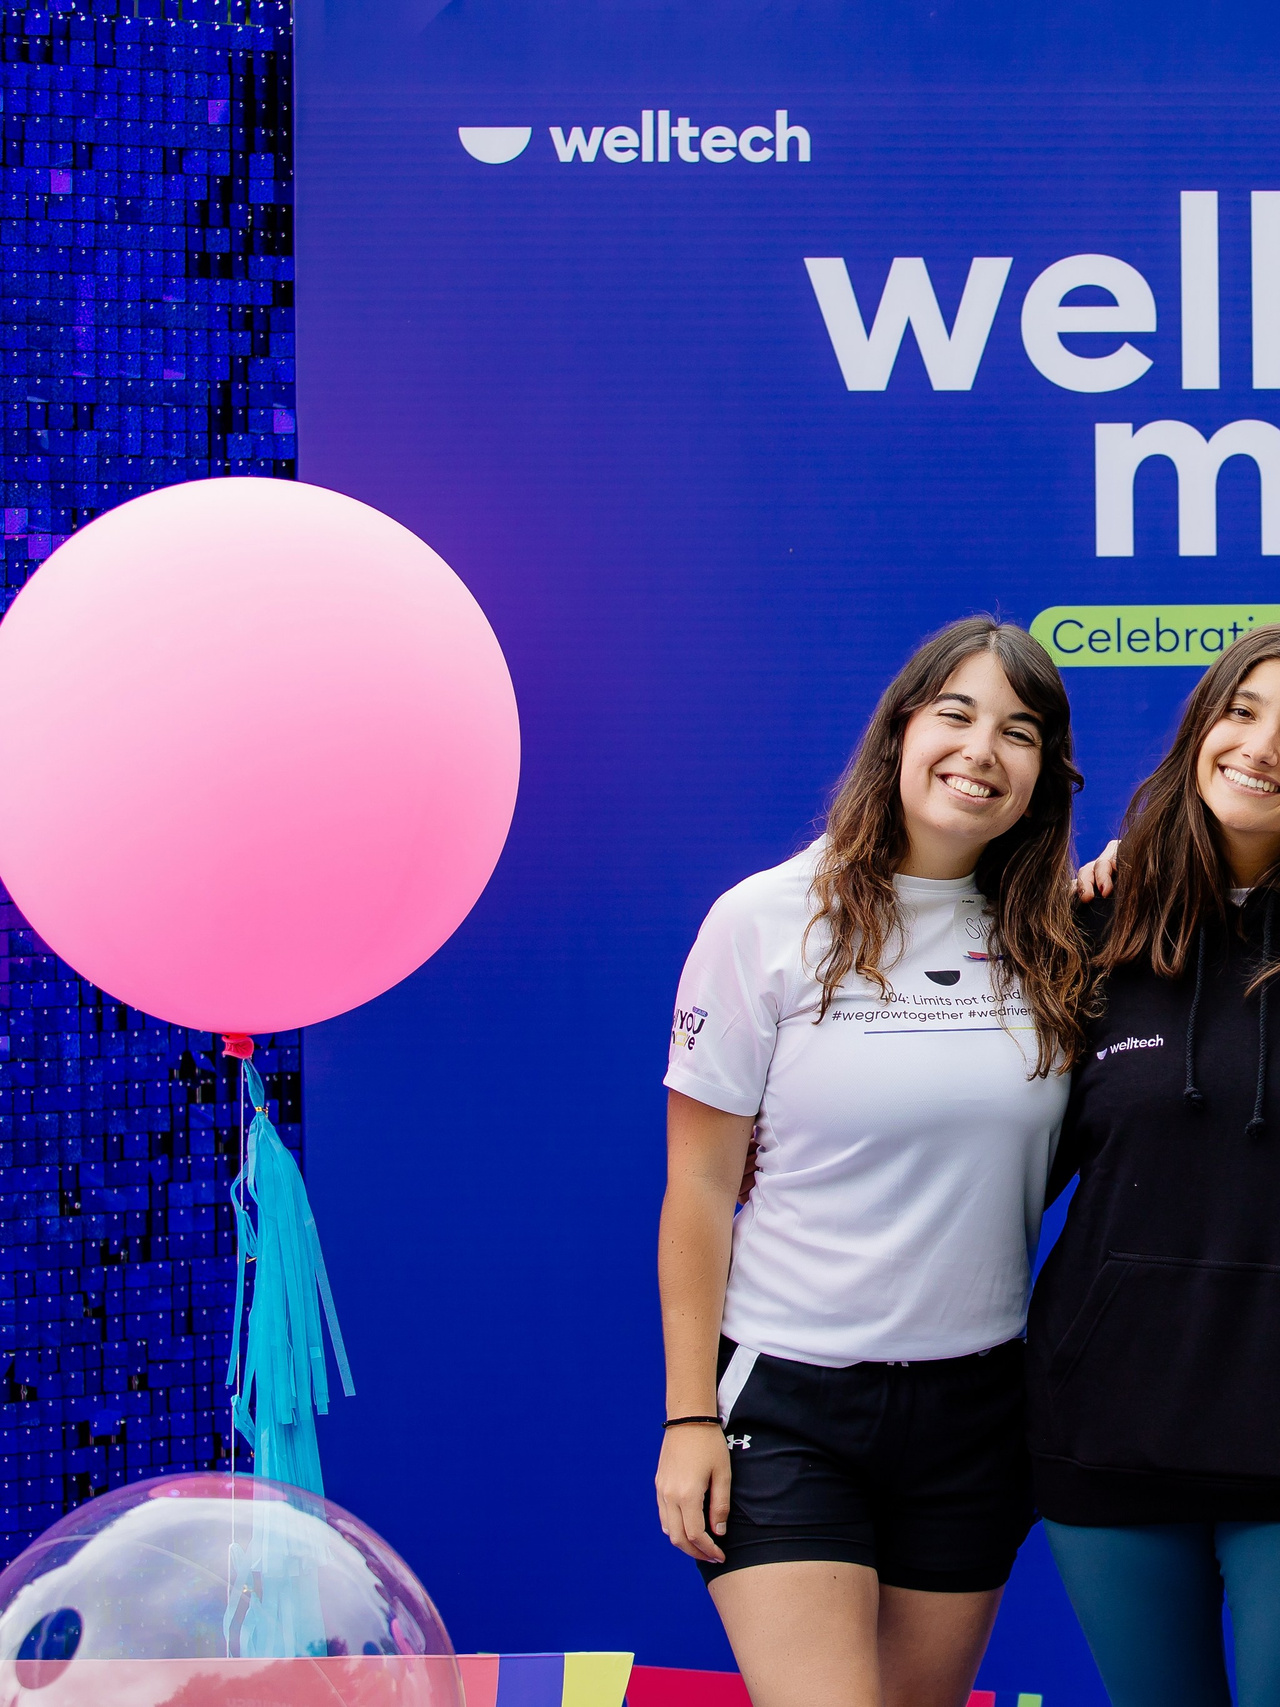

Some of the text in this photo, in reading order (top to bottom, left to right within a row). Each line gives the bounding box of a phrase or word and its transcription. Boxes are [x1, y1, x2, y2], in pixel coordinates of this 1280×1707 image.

[549, 110, 811, 163] welltech
[1052, 616, 1254, 654] Celebrat
[912, 994, 952, 1007] Limits
[955, 996, 980, 1006] not
[832, 1009, 963, 1023] #wegrowtogether
[1110, 1034, 1164, 1055] welltech
